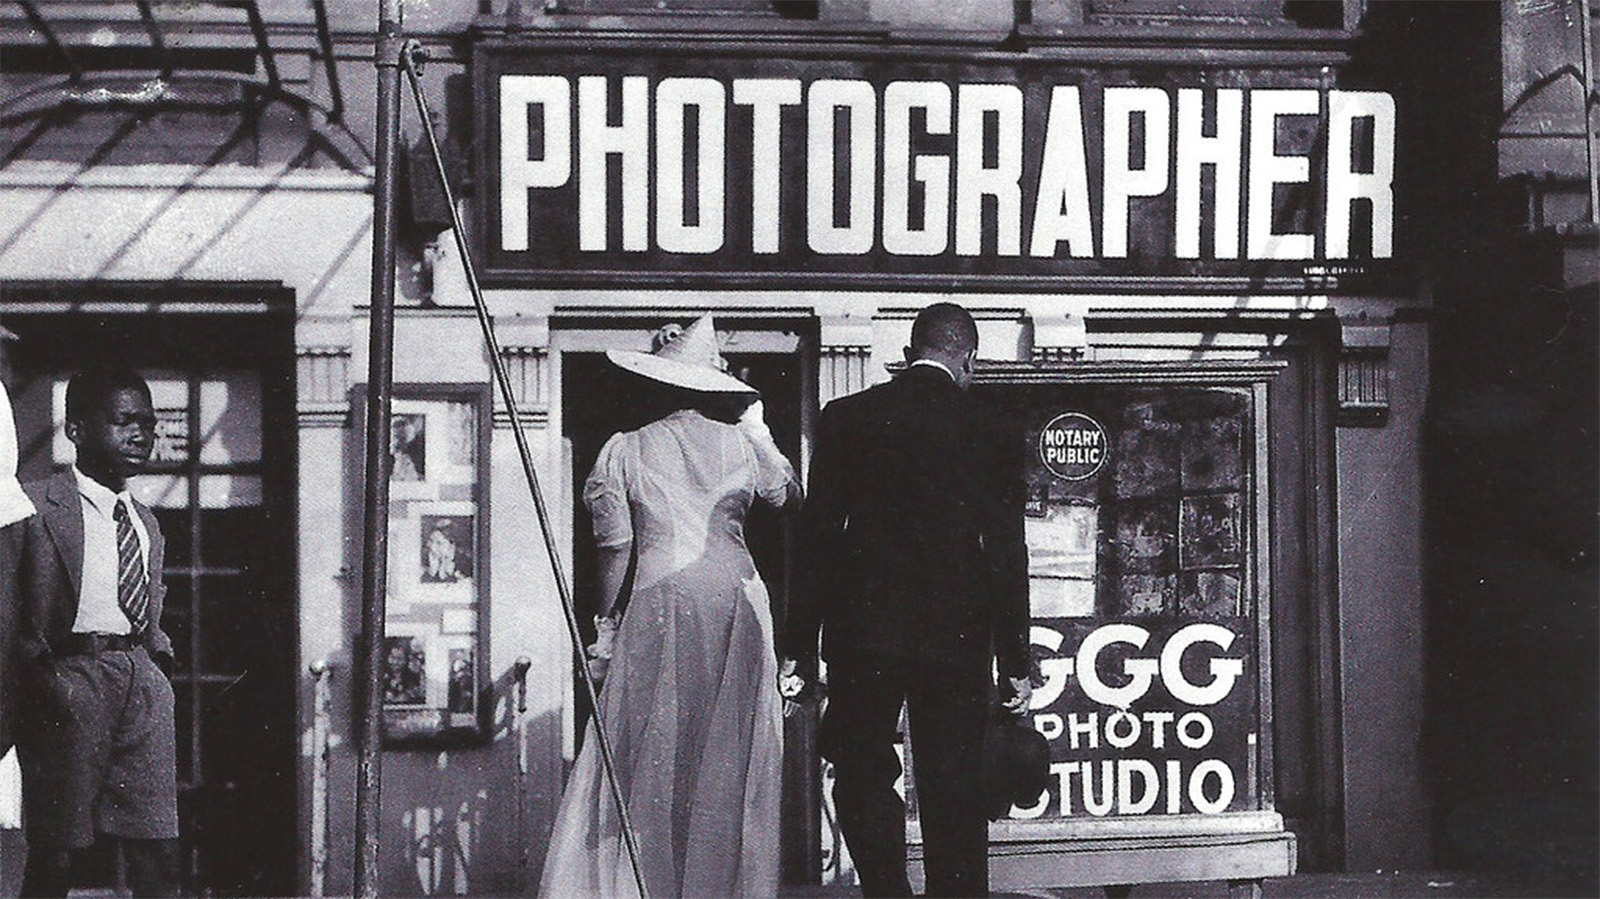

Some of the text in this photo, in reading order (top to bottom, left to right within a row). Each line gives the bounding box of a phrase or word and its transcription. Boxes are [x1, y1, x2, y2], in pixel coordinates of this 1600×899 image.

[500, 74, 1396, 260] PHOTOGRAPHER
[1045, 428, 1101, 446] NOTARY
[1047, 447, 1100, 465] PUBLIC
[1033, 711, 1214, 750] PHOTO
